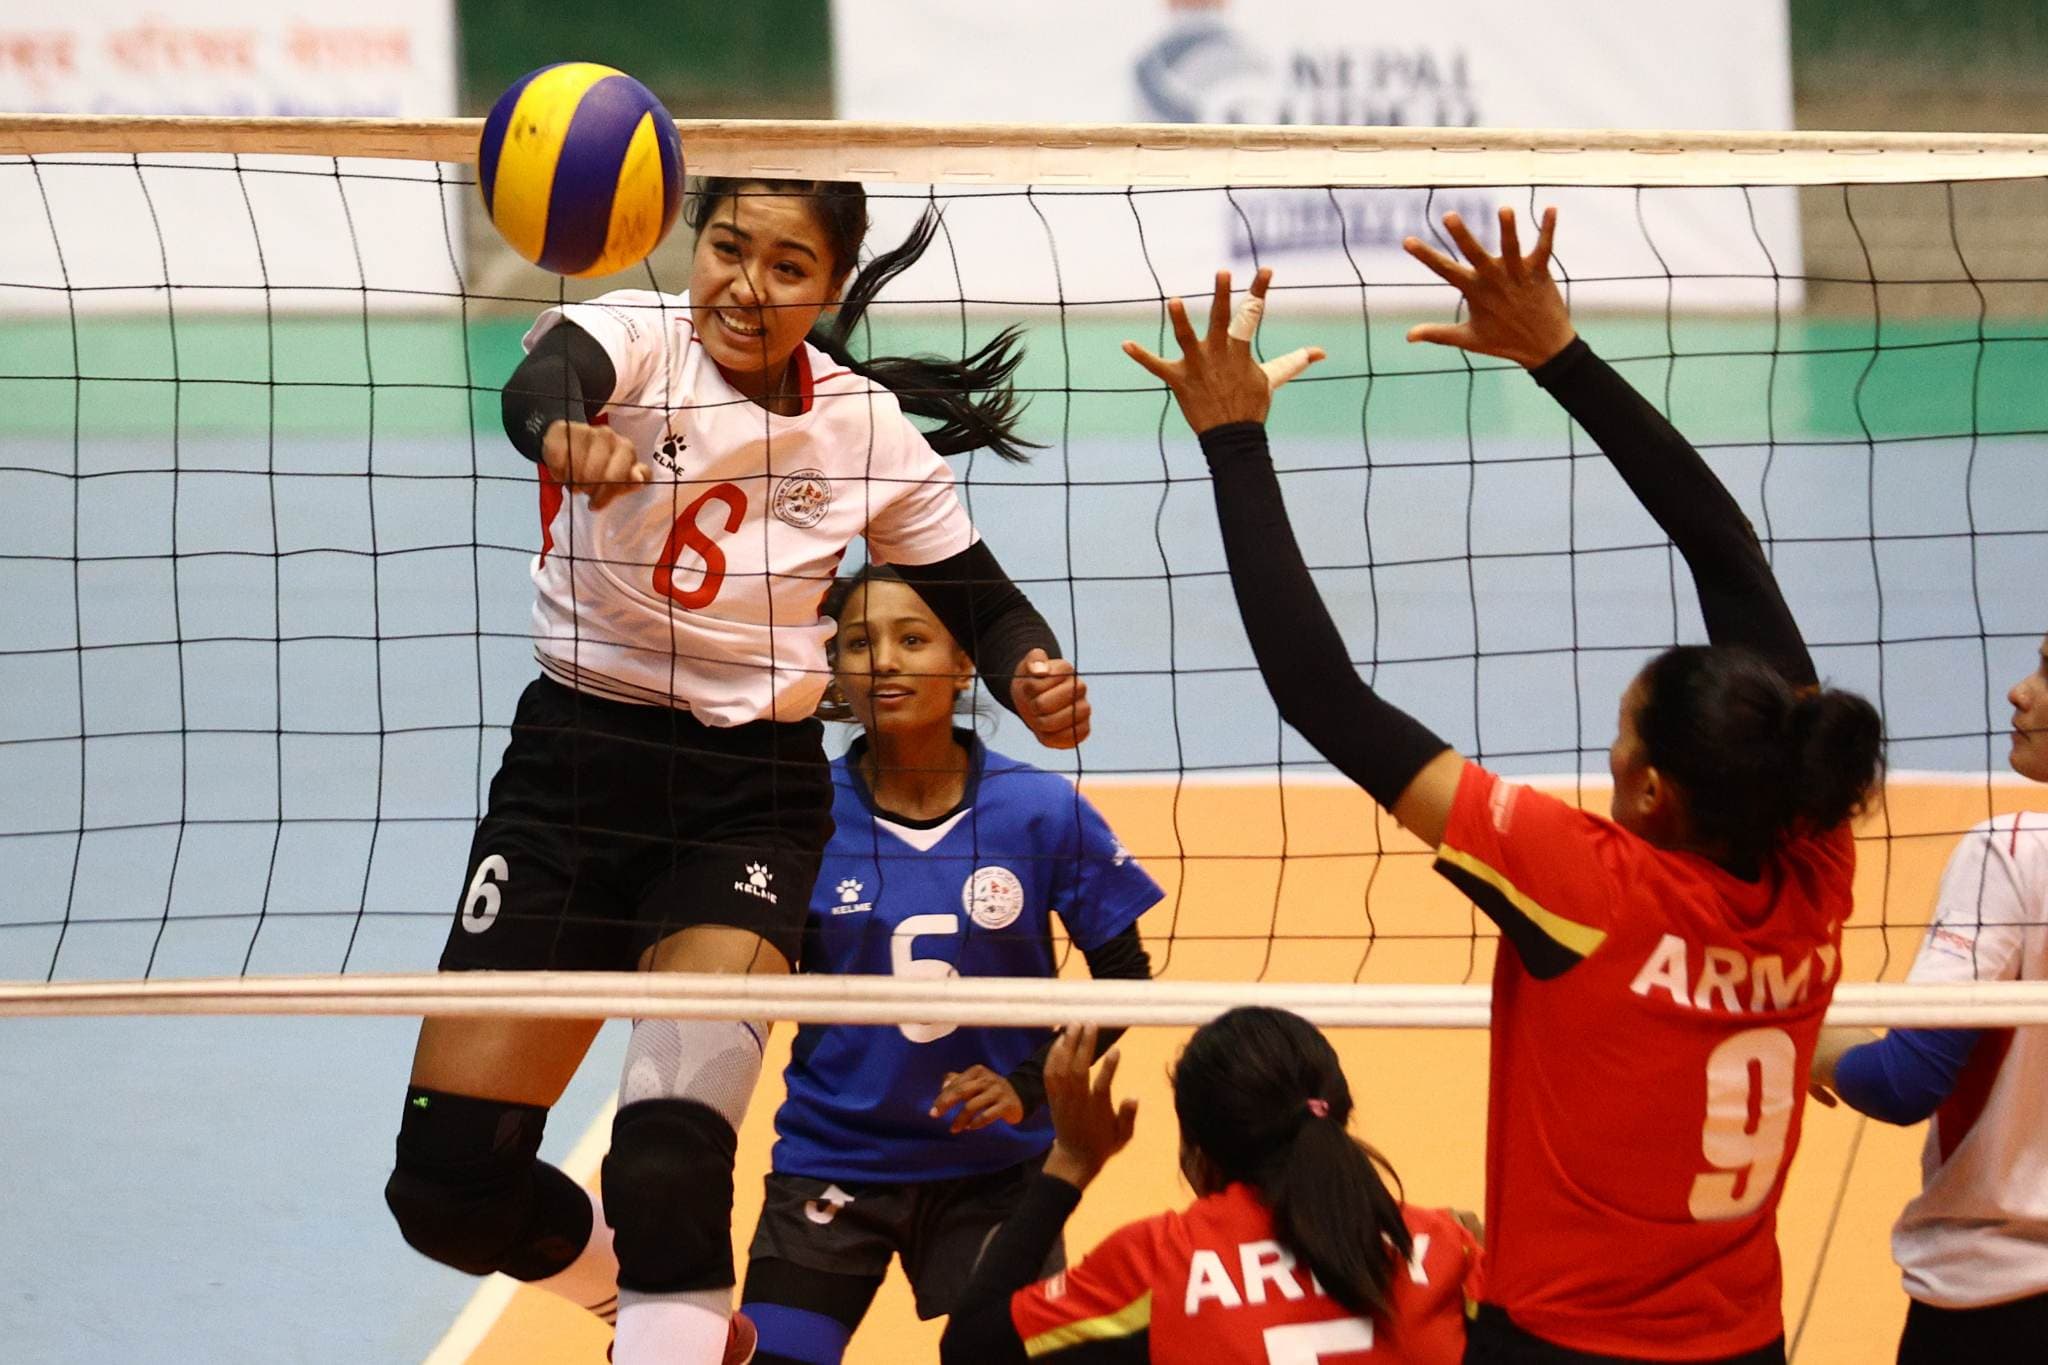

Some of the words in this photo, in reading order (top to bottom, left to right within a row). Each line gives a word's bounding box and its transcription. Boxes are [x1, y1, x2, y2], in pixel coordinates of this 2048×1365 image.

[653, 451, 684, 477] ELME
[652, 482, 748, 609] 6
[462, 854, 509, 934] 6
[734, 881, 777, 904] KELME
[831, 902, 873, 915] KELME
[1688, 1027, 1797, 1221] 9
[1185, 1233, 1430, 1316] ARY
